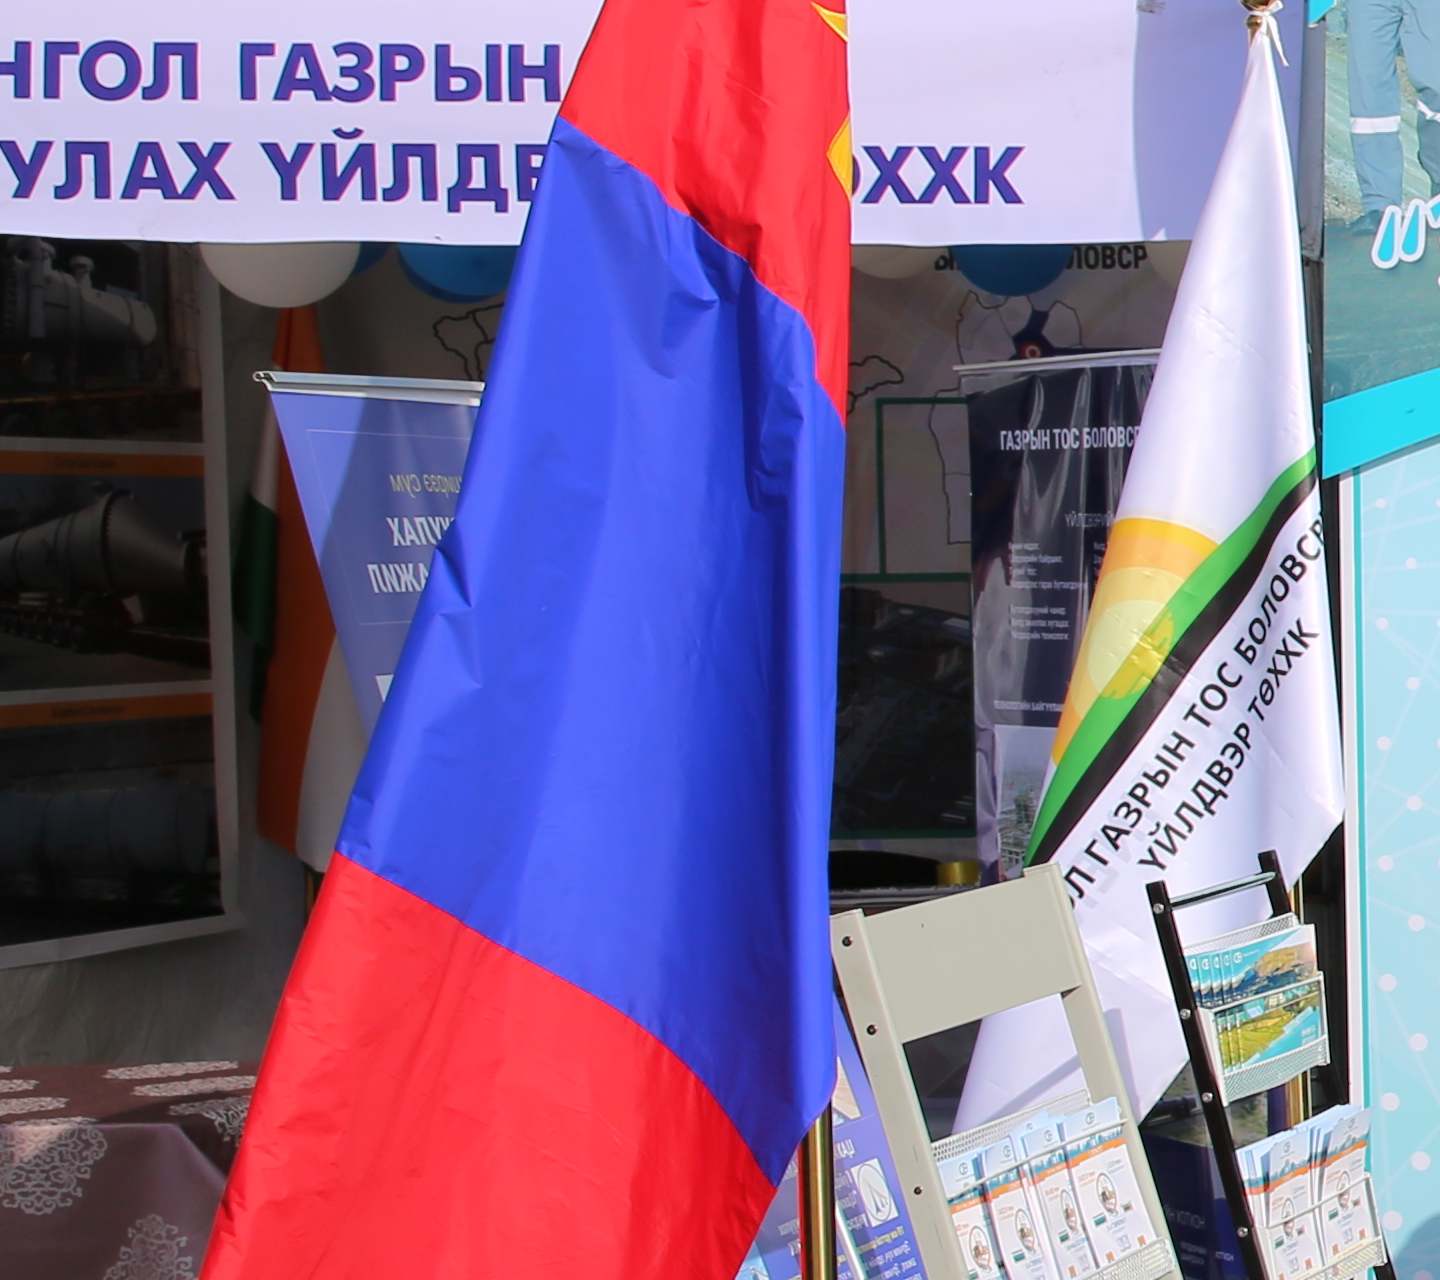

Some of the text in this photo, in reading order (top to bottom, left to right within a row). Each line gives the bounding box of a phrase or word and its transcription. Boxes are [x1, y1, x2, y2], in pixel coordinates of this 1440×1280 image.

[239, 40, 561, 104] ГАЗРЫН
[852, 144, 1025, 205] ХХК
[1000, 429, 1051, 451] ГАЗРЫН
[1054, 429, 1081, 450] ТОС
[1085, 732, 1195, 867] ГАЗРЫН
[1185, 662, 1243, 728] ТОС
[1138, 722, 1252, 873] ҮЙЛДВЭР
